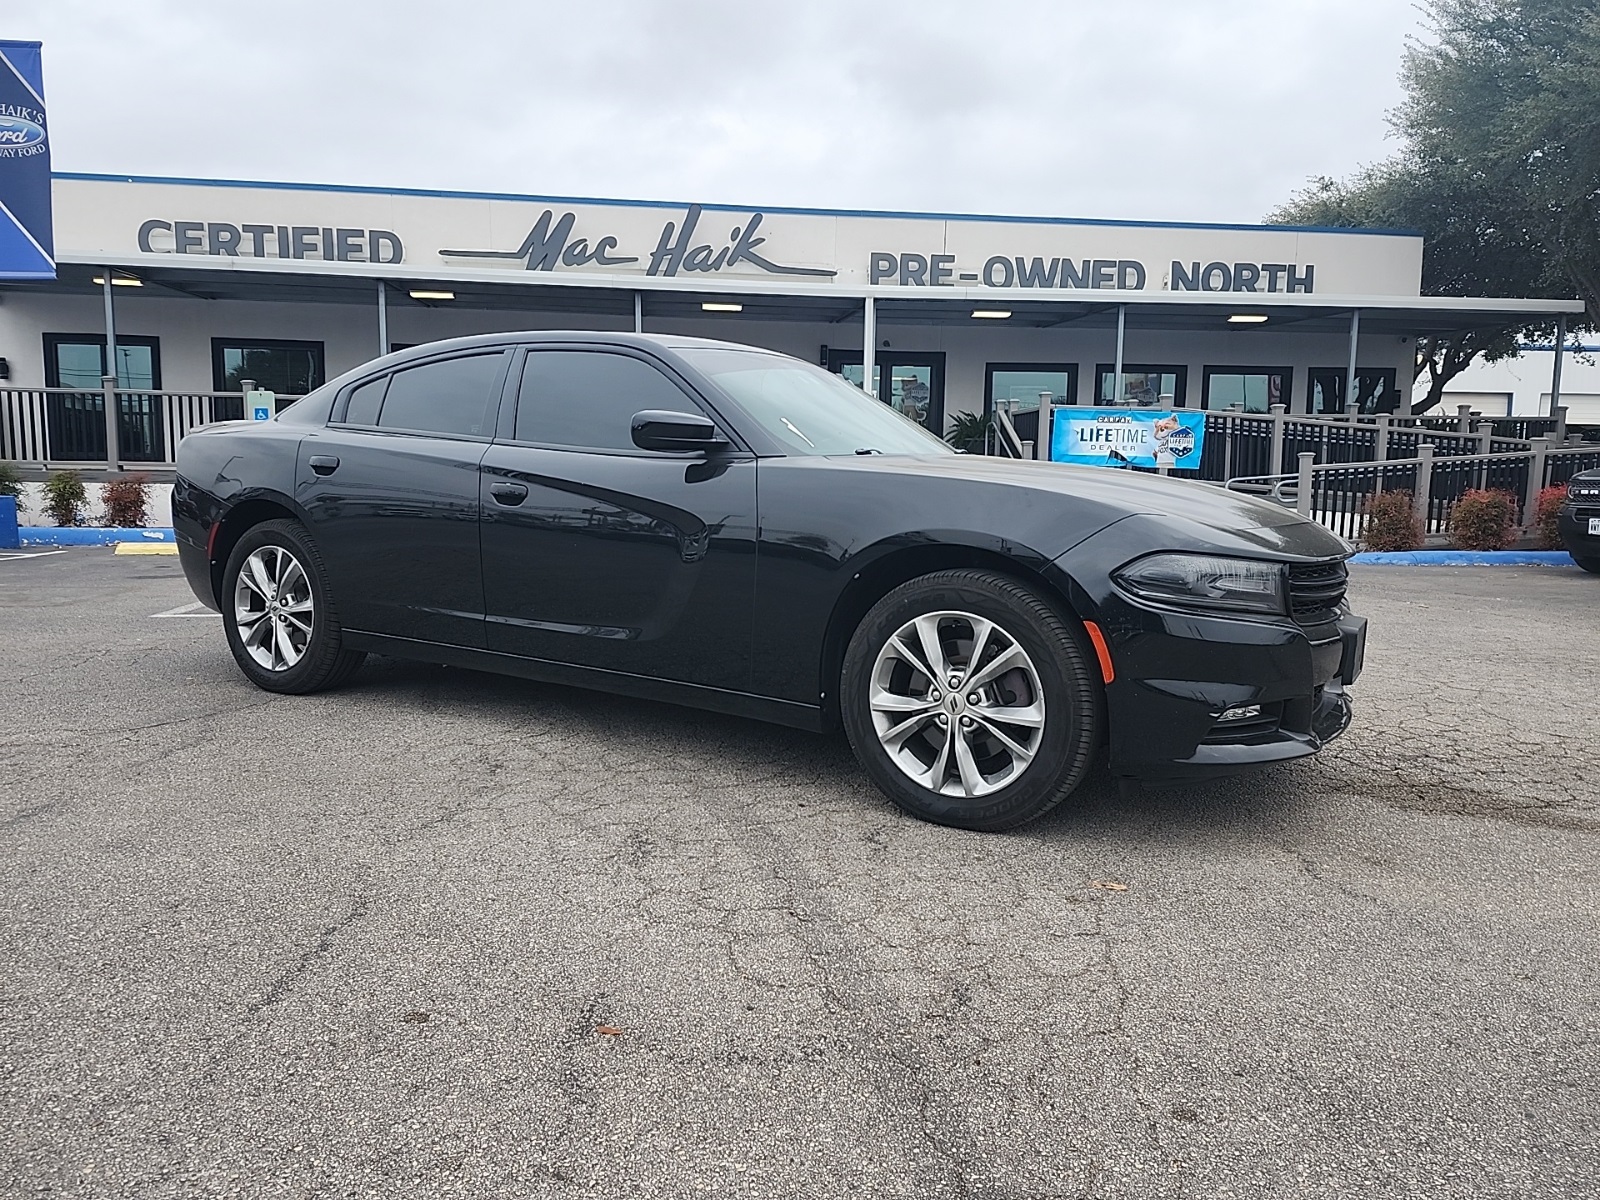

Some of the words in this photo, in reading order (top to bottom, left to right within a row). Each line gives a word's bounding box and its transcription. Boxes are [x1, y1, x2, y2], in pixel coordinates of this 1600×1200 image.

[18, 144, 46, 157] FORD
[137, 219, 404, 264] CERTIFIED
[439, 210, 638, 271] Mac
[646, 204, 838, 277] Haik
[869, 252, 1147, 290] PRE-OWNED
[1170, 260, 1315, 293] NORTH
[1097, 416, 1132, 424] CARFAX
[1079, 427, 1148, 444] LIFETIME
